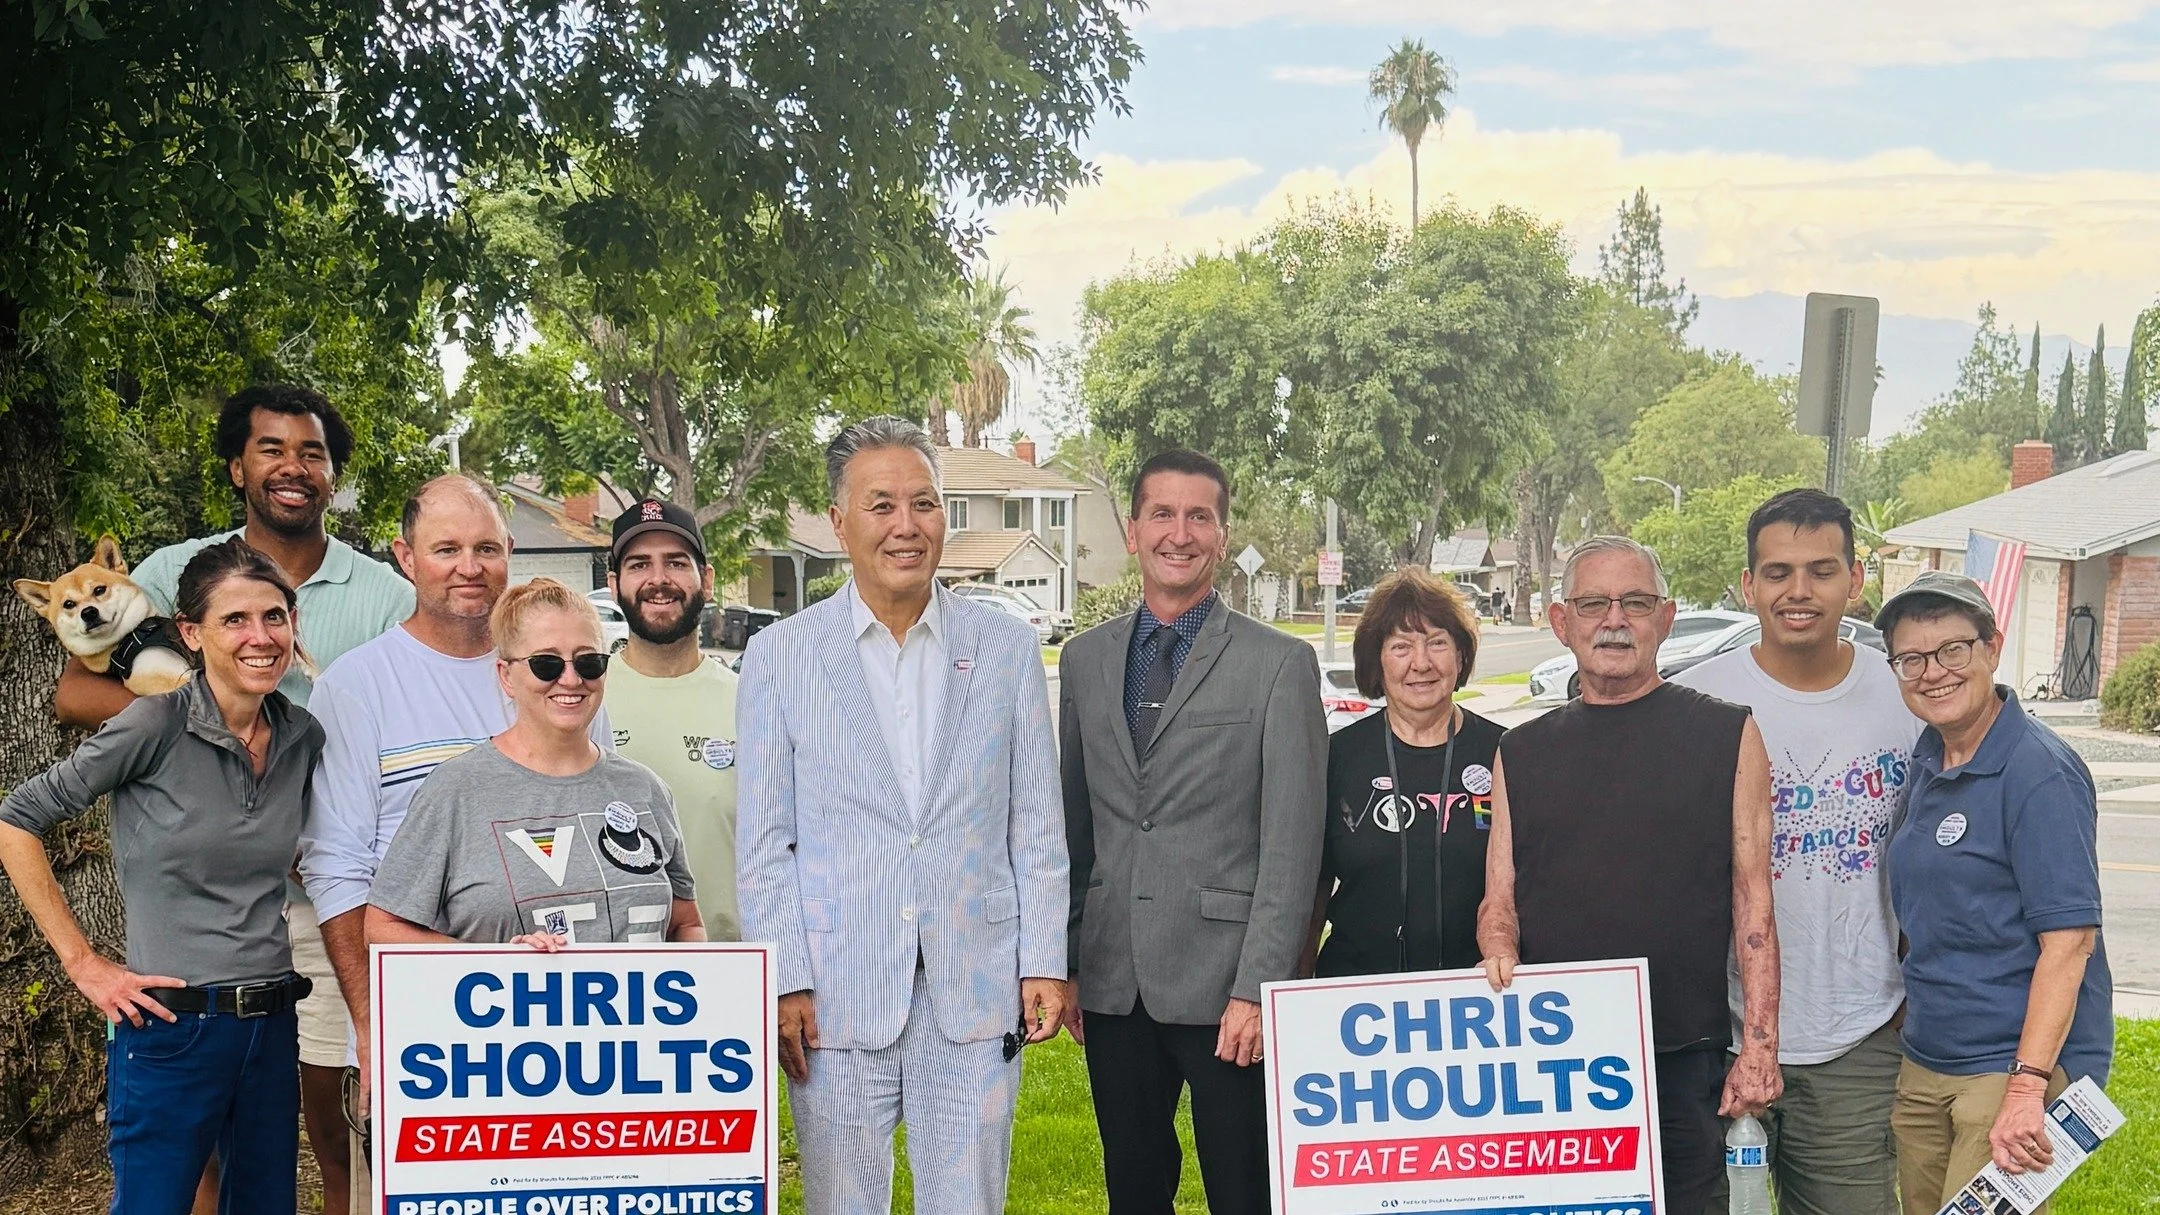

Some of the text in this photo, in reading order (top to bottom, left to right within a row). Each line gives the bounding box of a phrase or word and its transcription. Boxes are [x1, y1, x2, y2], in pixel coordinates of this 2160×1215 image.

[1819, 793, 1845, 812] my
[1844, 752, 1906, 799] GUTS
[454, 970, 699, 1029] CHRIS
[1340, 991, 1574, 1057] CHRIS
[399, 1038, 753, 1100] SHOULTS
[1293, 1056, 1634, 1127] SHOULTS
[414, 1117, 741, 1154] STATE ASSEMBLY
[1309, 1136, 1624, 1179] STATE ASSEMBLY
[399, 1189, 755, 1215] PEOPLE OVER POLITICS
